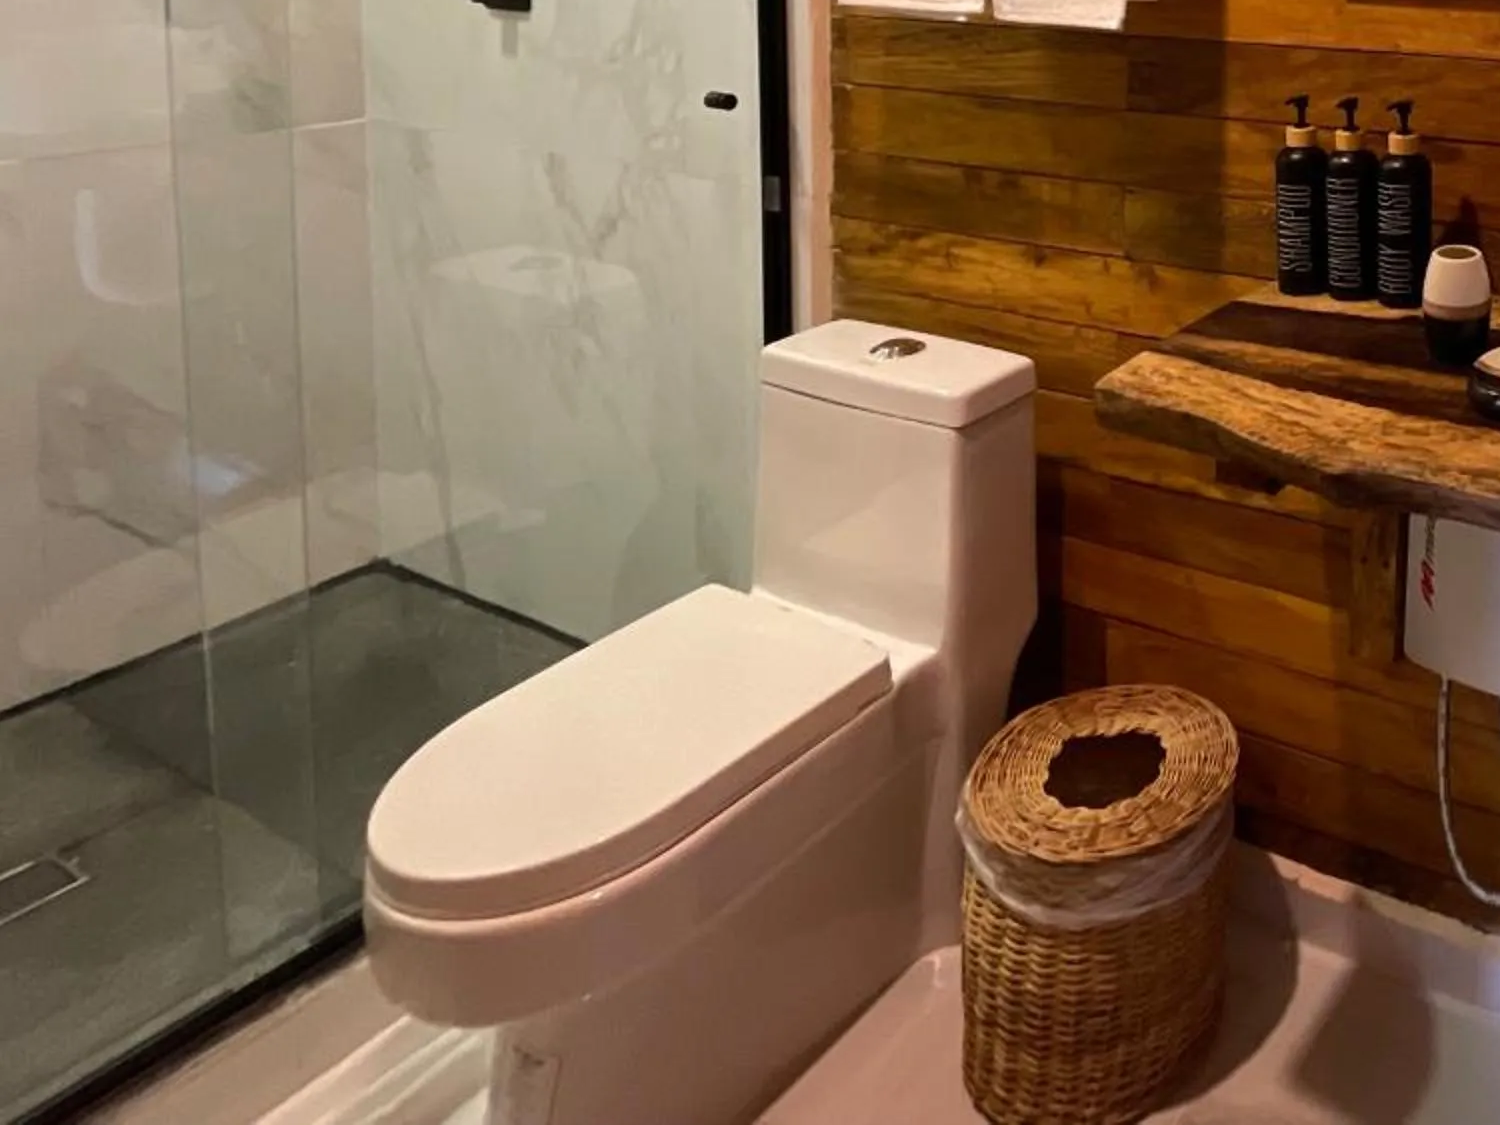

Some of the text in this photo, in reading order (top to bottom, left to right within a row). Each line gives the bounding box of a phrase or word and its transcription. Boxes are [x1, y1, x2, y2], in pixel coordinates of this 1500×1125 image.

[1278, 183, 1313, 273] SHAMPOO
[1325, 177, 1362, 288] CONDITIONER
[1377, 181, 1413, 294] BODY WASH
